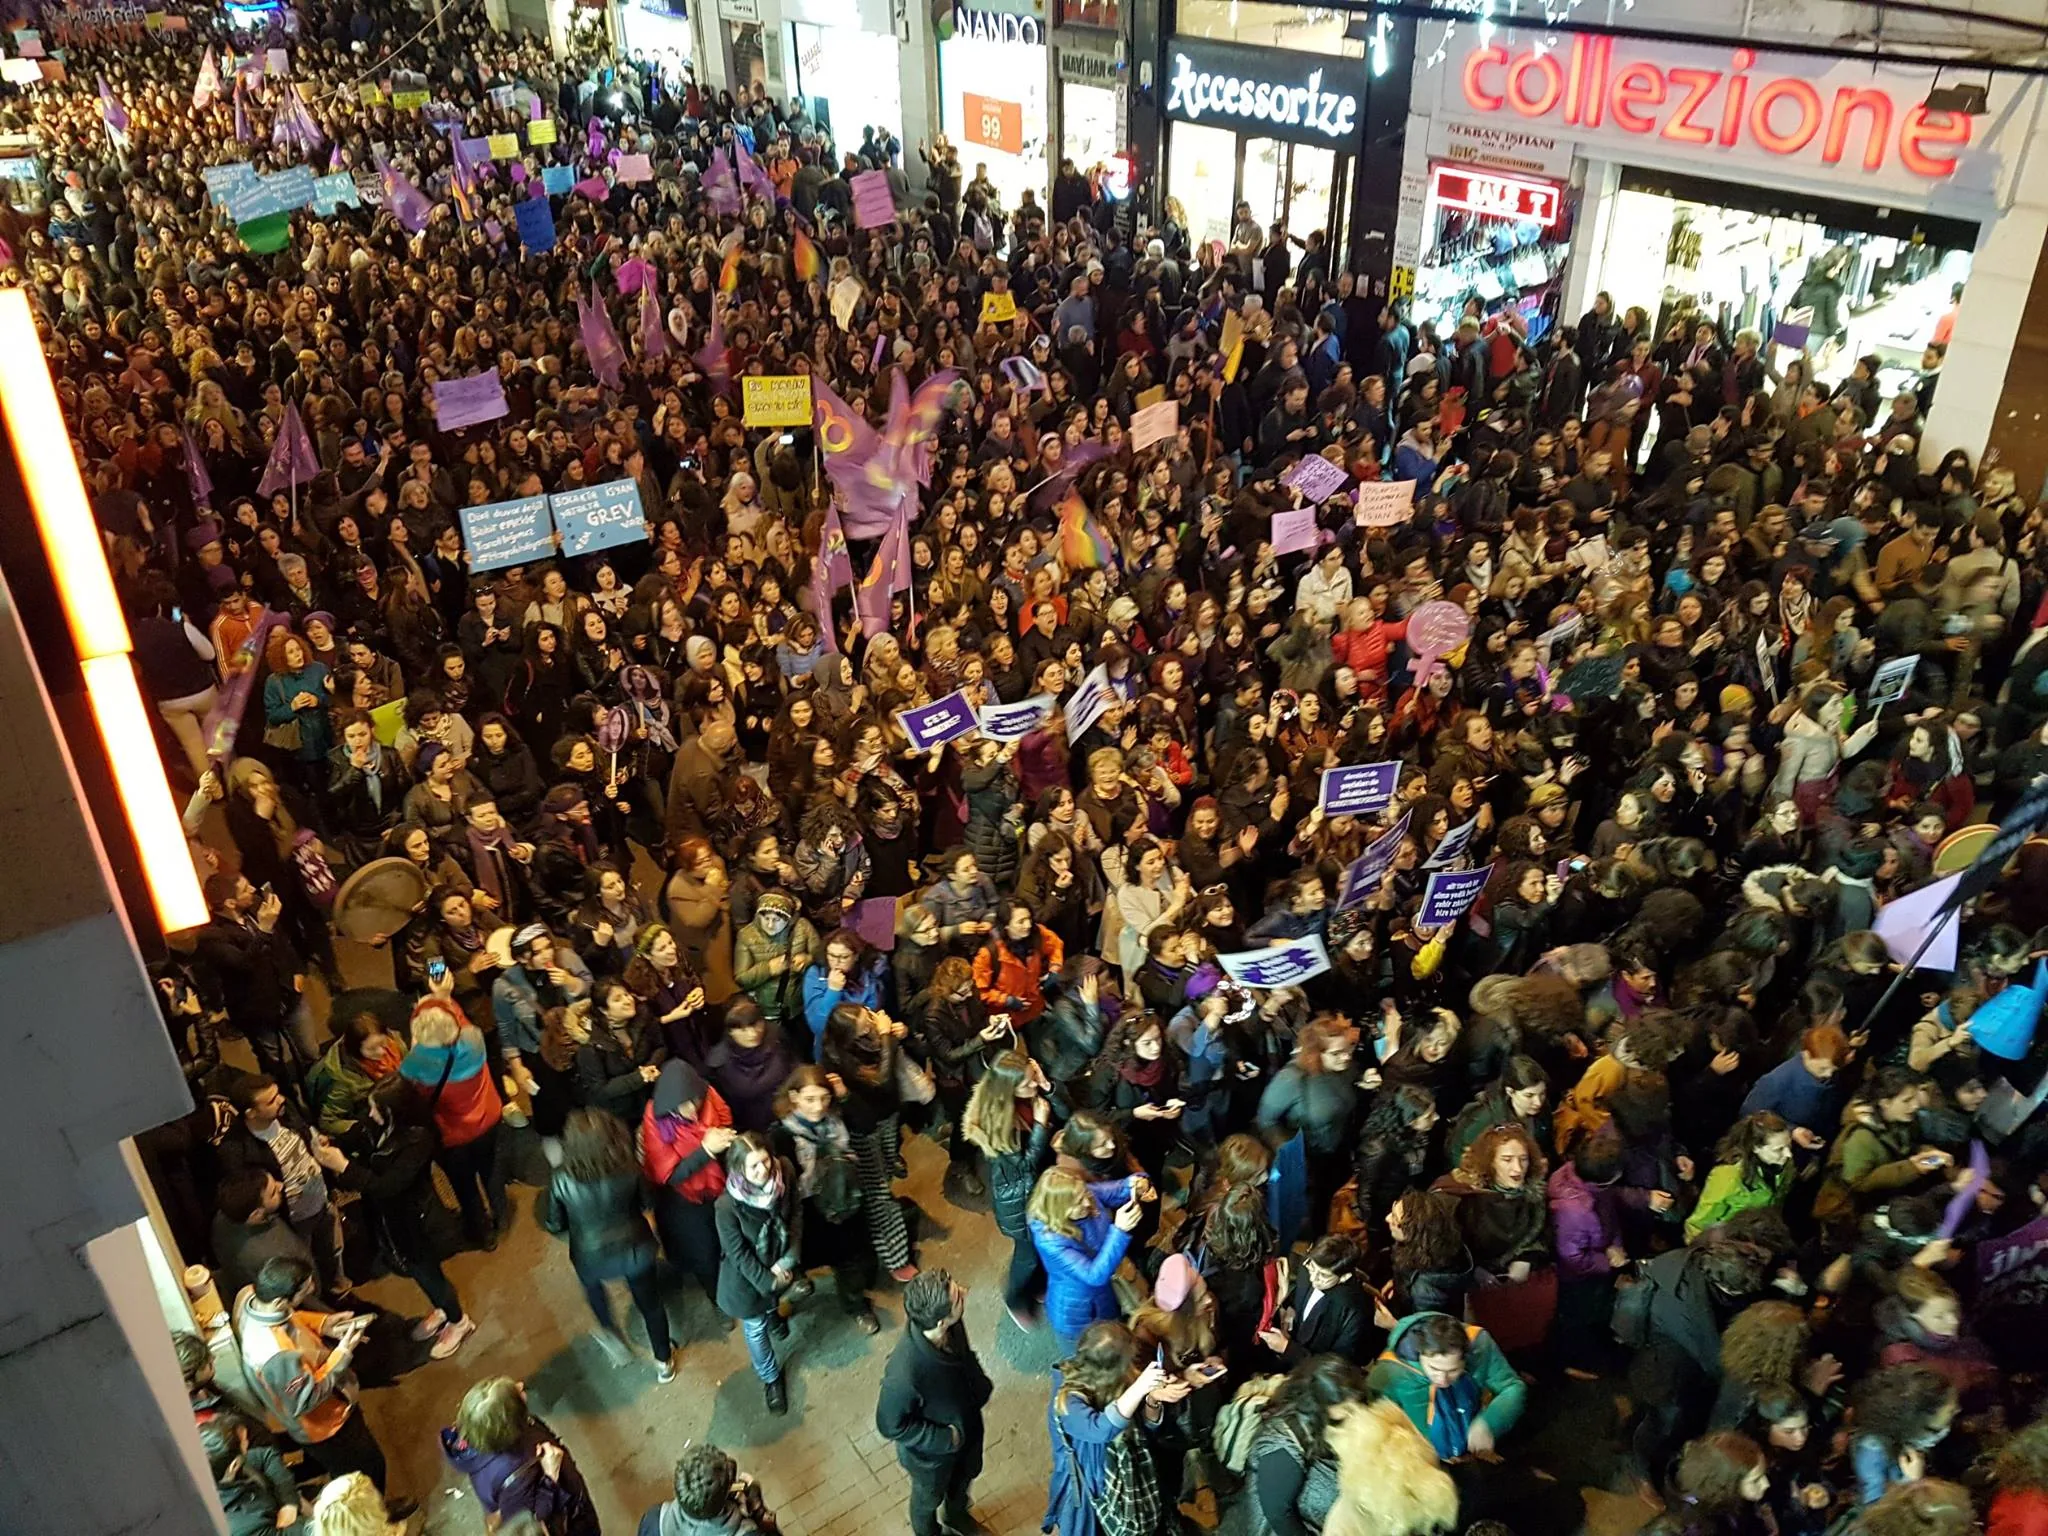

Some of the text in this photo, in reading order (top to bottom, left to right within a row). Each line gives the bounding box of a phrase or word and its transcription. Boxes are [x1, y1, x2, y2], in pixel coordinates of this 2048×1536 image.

[1086, 57, 1106, 78] HAN
[1167, 53, 1357, 137] Accessorize
[1462, 32, 1973, 177] collezione
[587, 500, 634, 527] GREV
